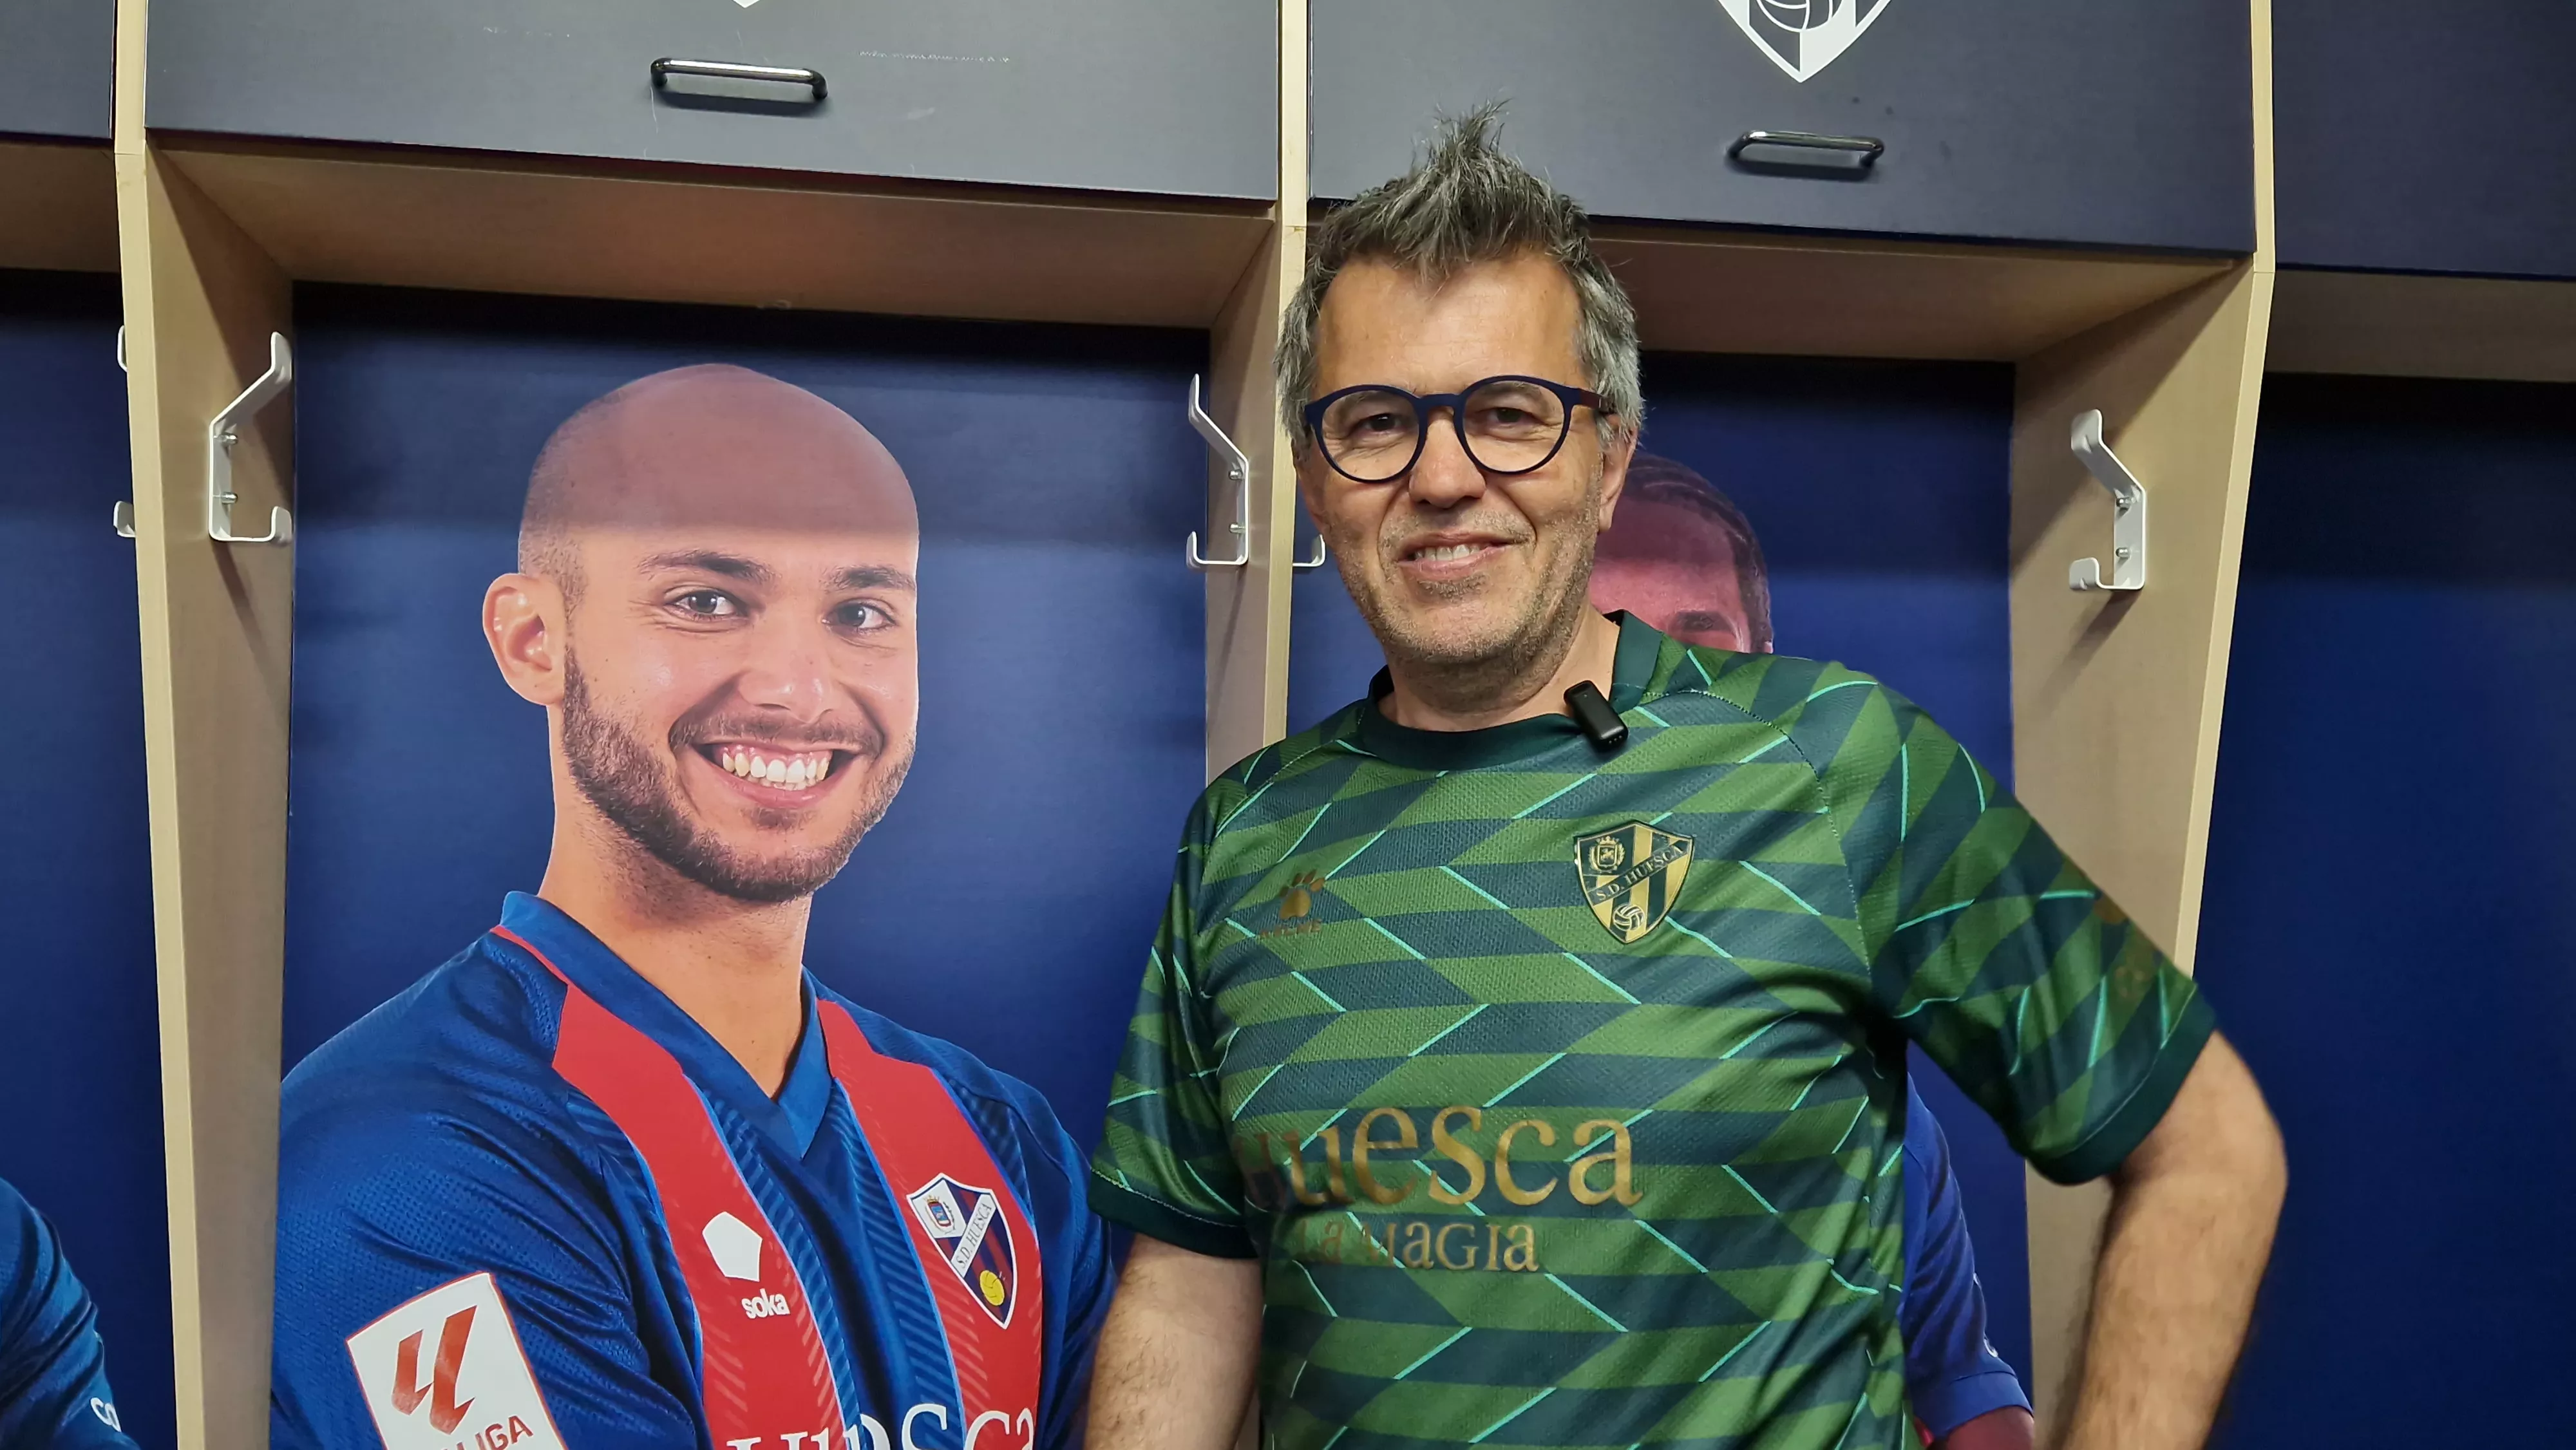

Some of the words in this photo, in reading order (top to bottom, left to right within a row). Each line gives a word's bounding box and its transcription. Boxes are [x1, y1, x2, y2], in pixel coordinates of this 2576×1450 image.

[1625, 844, 1683, 886] HUESCA
[965, 1202, 992, 1247] HUESCA
[741, 1288, 791, 1319] soka
